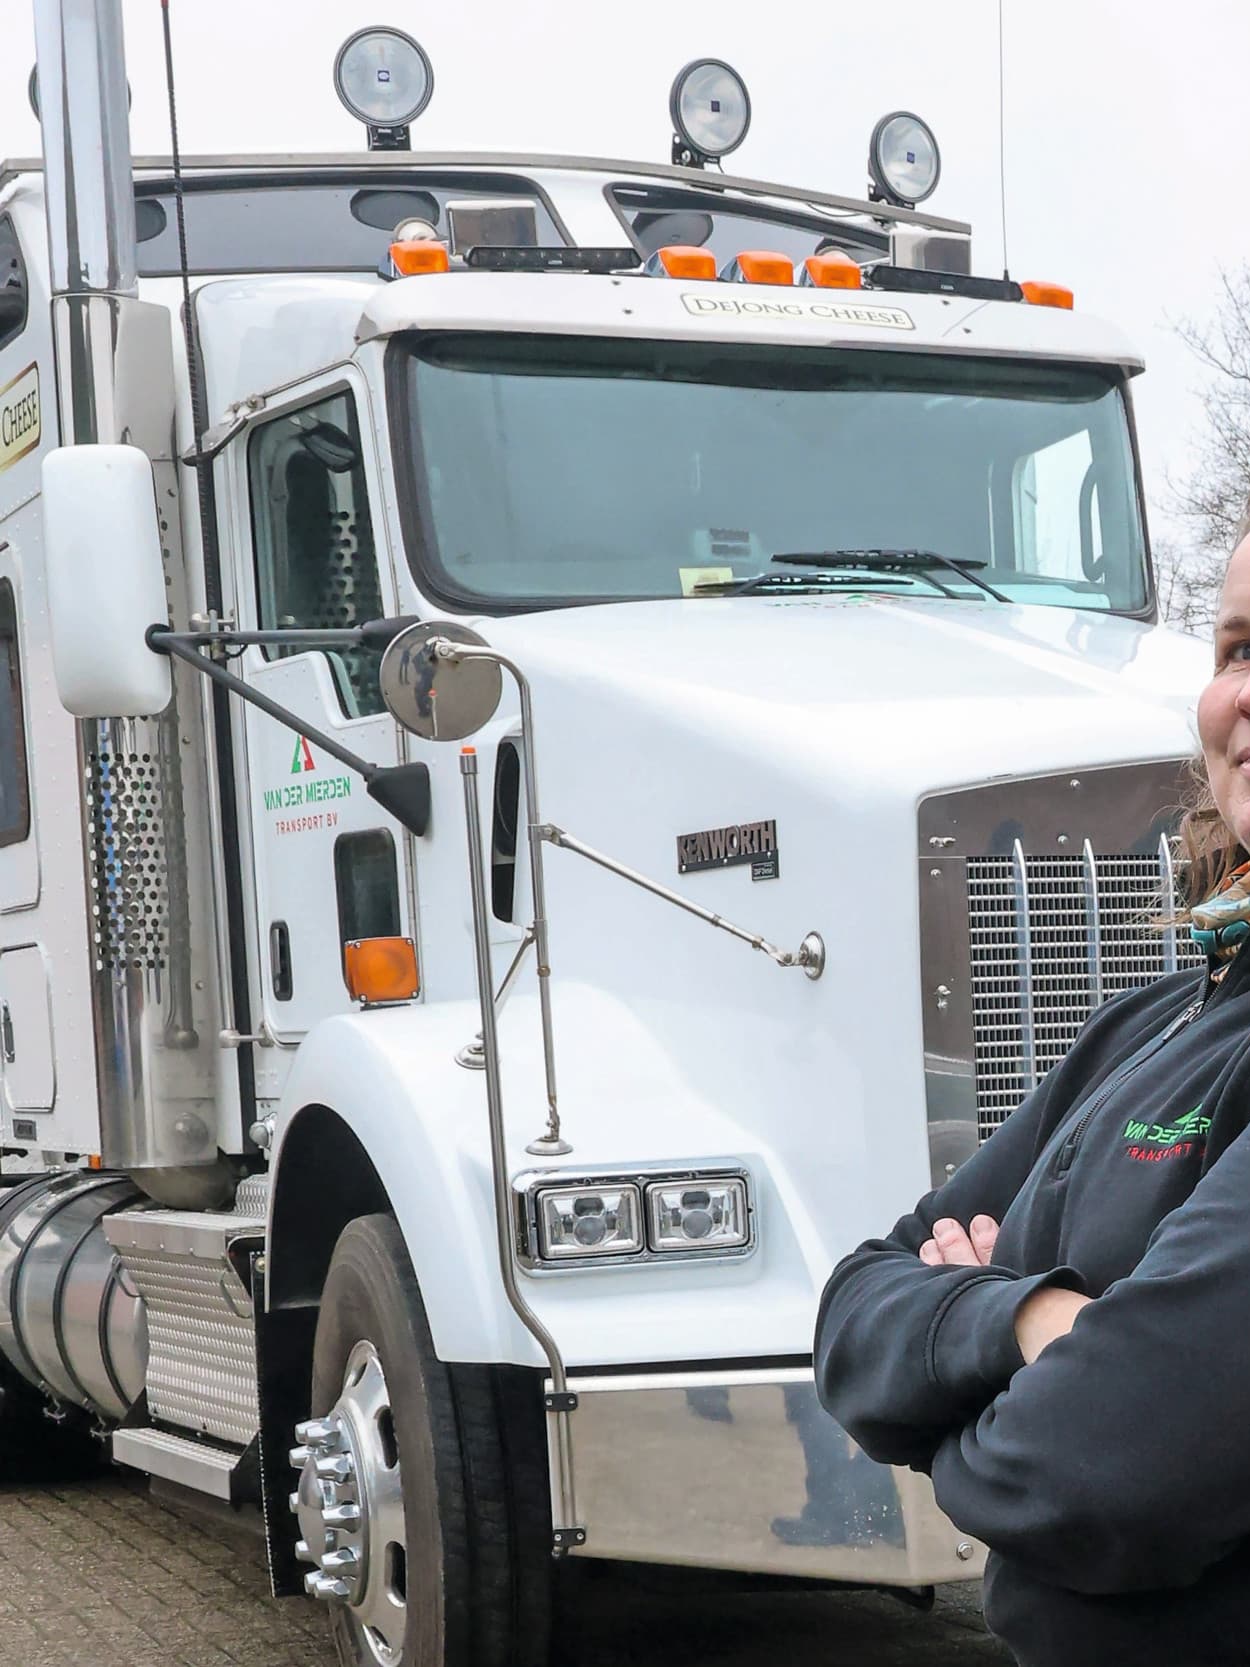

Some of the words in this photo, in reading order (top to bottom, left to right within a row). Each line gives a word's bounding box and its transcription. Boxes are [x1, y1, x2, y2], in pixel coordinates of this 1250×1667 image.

[810, 305, 906, 326] CHEESE
[2, 389, 37, 447] CHEESE
[264, 789, 282, 811] VAN
[284, 785, 303, 807] DER
[305, 776, 351, 802] MIERDEN
[275, 814, 323, 835] TRANSPORT
[327, 812, 338, 828] BV
[677, 819, 776, 864] KENWORTH
